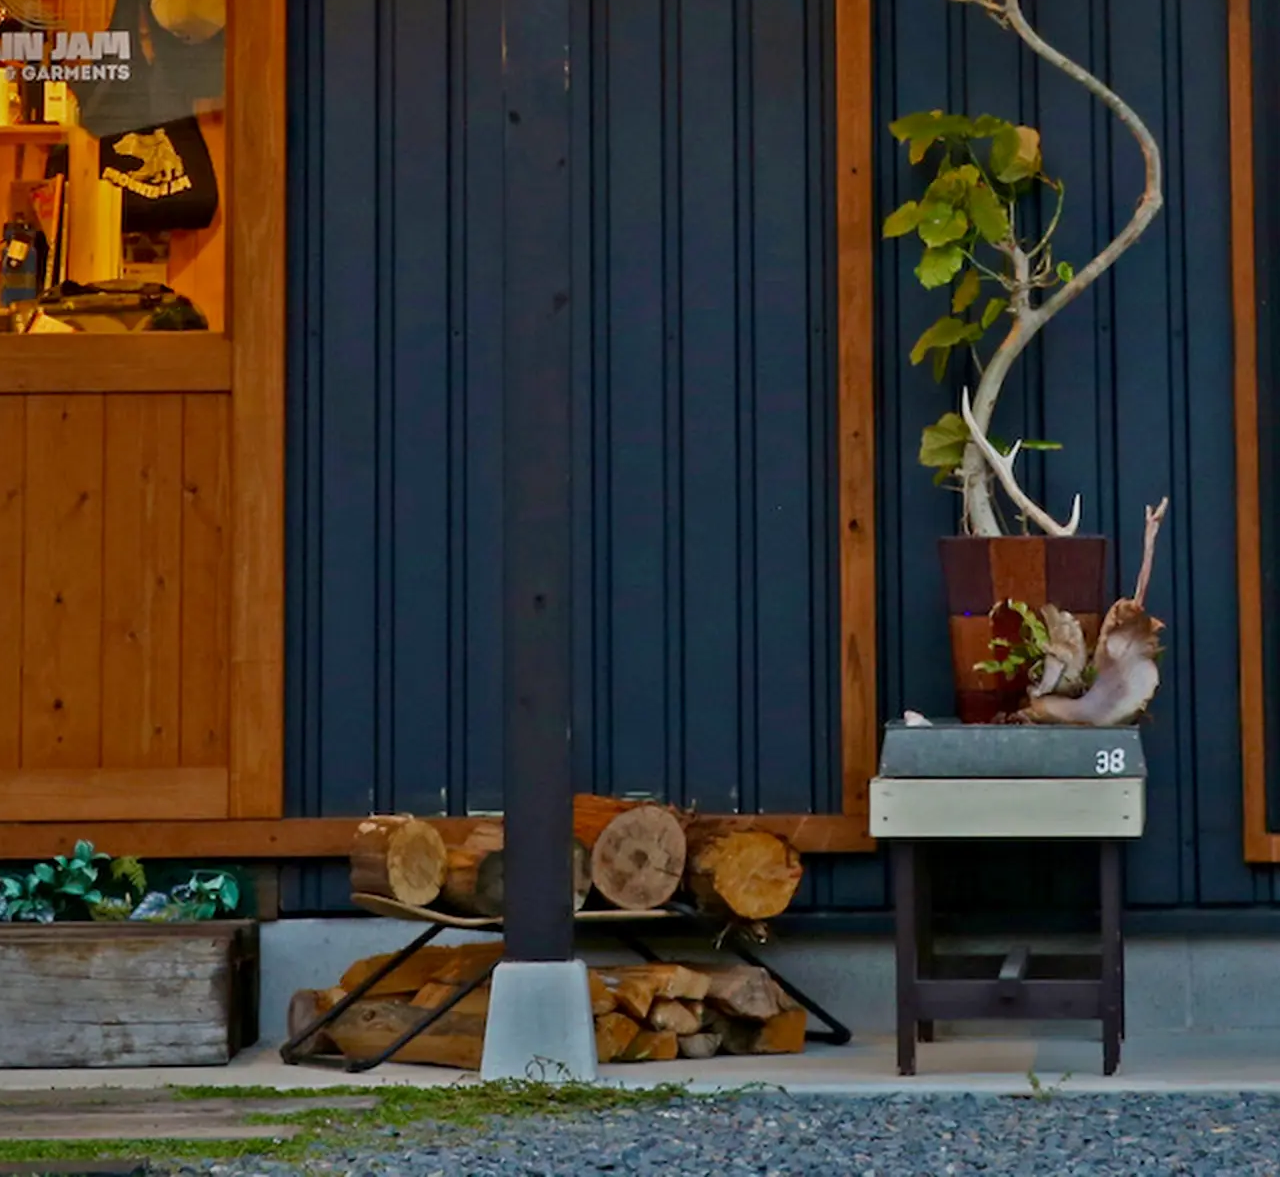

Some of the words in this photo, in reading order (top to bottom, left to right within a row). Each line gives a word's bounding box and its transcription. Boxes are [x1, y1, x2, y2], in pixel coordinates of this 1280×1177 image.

[50, 30, 131, 61] JAM
[21, 63, 131, 81] GARMENTS
[1095, 747, 1126, 775] 38
